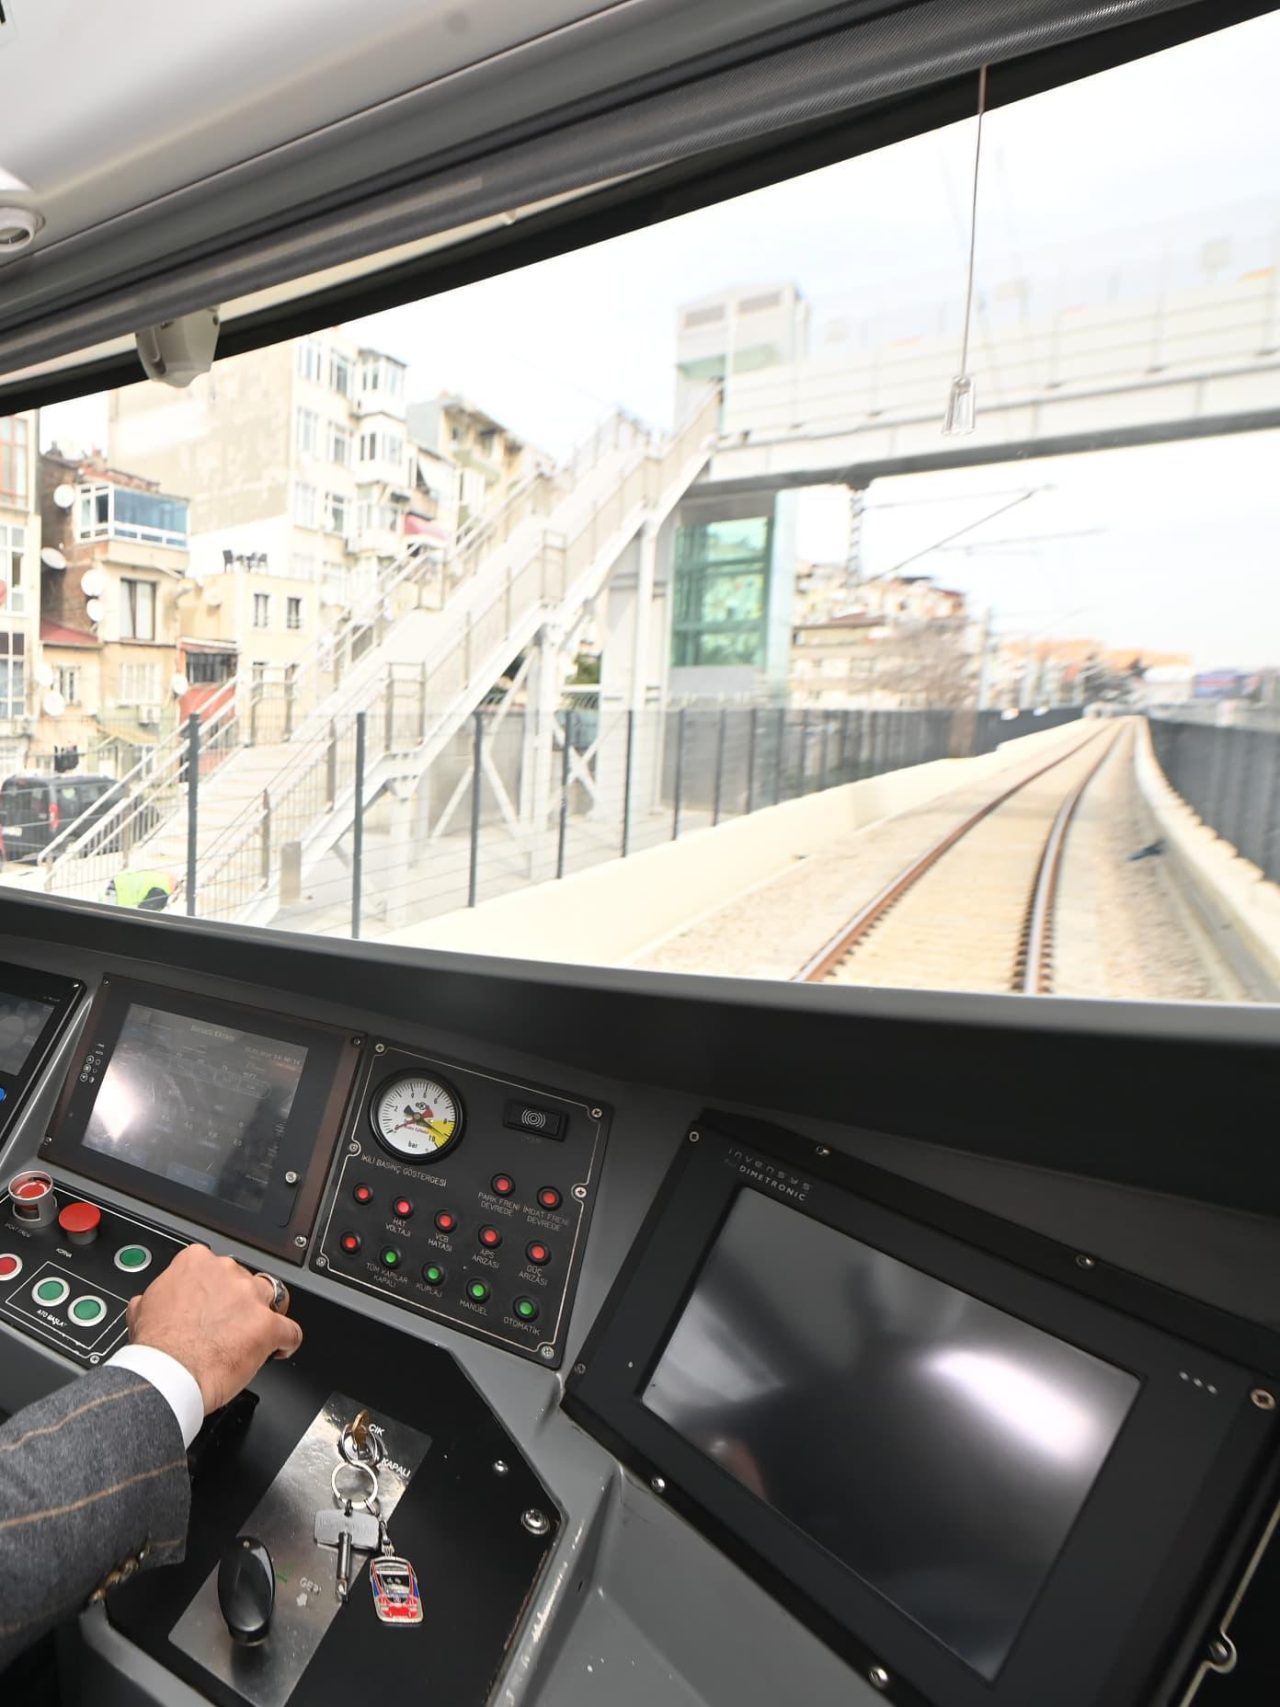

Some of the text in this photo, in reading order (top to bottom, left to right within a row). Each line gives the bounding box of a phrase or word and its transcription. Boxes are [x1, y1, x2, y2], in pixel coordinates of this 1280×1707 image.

[407, 1140, 418, 1149] bar
[728, 1145, 811, 1191] invensys
[739, 1164, 807, 1201] DIMETRONIC
[393, 1216, 407, 1226] HAT
